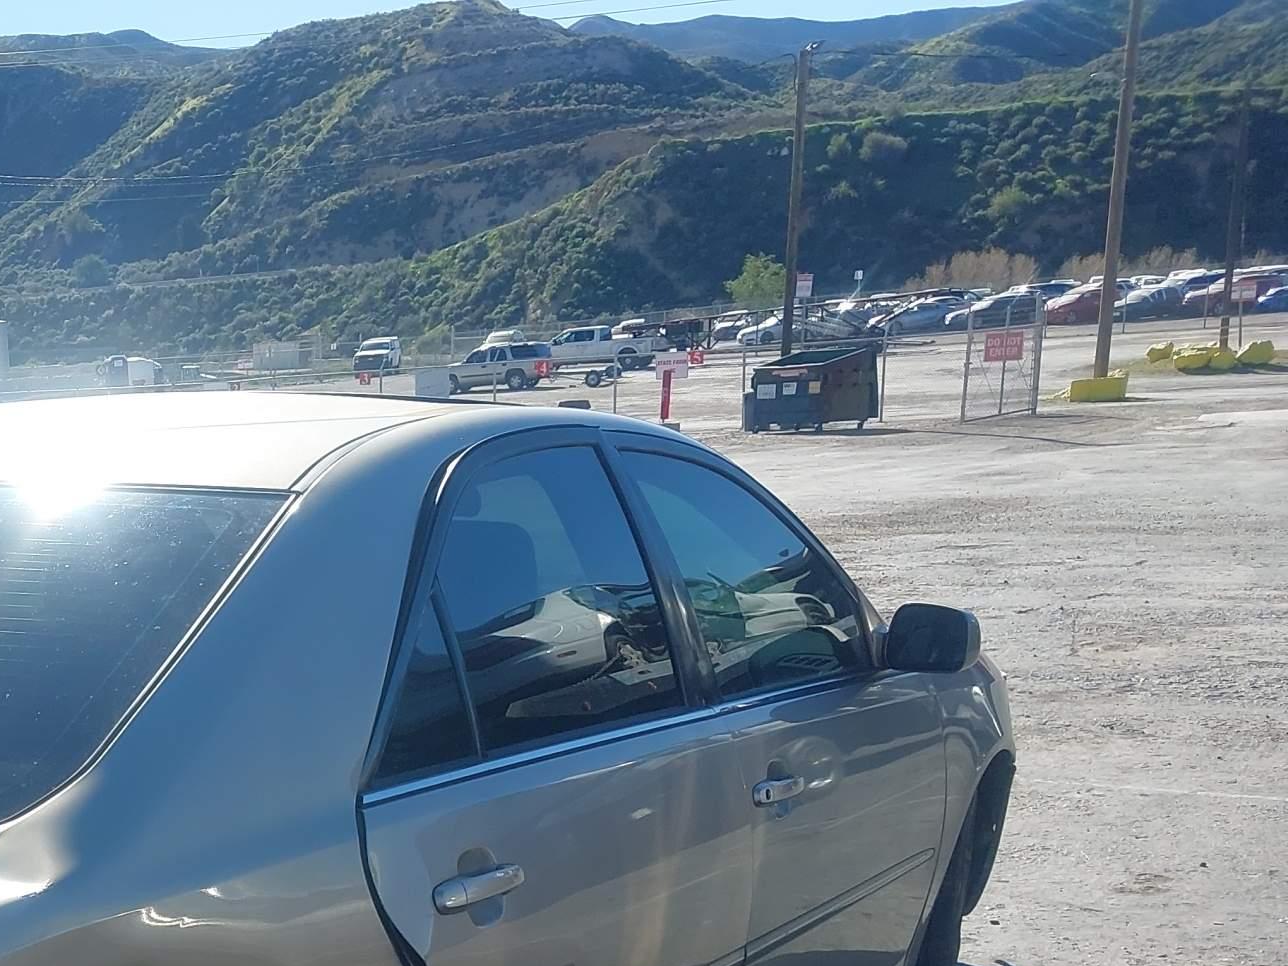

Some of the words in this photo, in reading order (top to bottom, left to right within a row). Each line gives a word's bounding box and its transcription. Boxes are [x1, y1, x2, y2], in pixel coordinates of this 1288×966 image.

[987, 337, 1000, 347] DO
[1003, 336, 1022, 346] NOT
[989, 346, 1019, 358] ENTER
